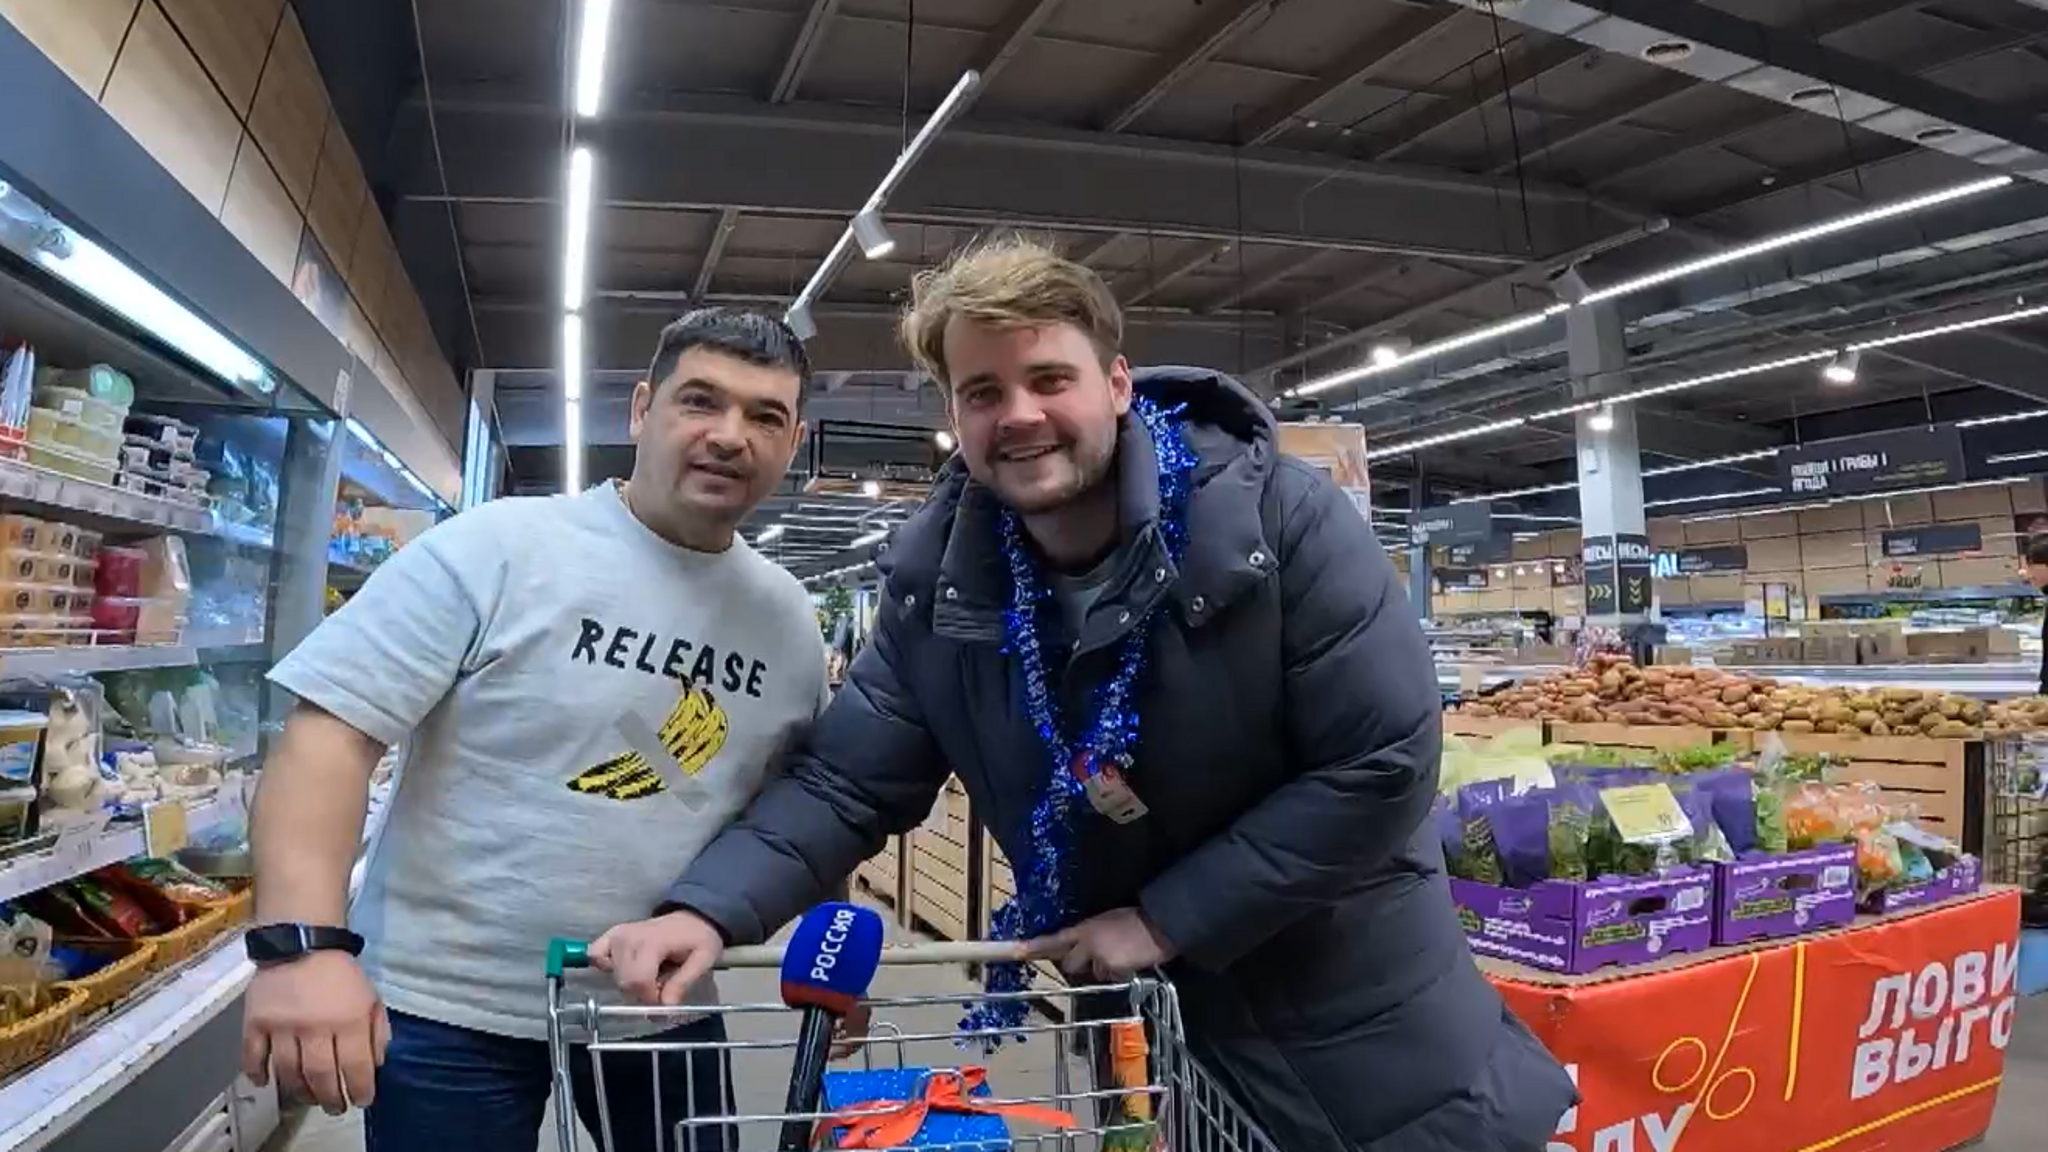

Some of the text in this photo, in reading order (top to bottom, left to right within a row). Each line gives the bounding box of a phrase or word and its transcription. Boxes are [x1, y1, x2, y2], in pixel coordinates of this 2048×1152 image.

[571, 618, 767, 698] RELEASE
[810, 909, 857, 981] РОССИЯ
[1858, 940, 2020, 1038] ЛОВИ
